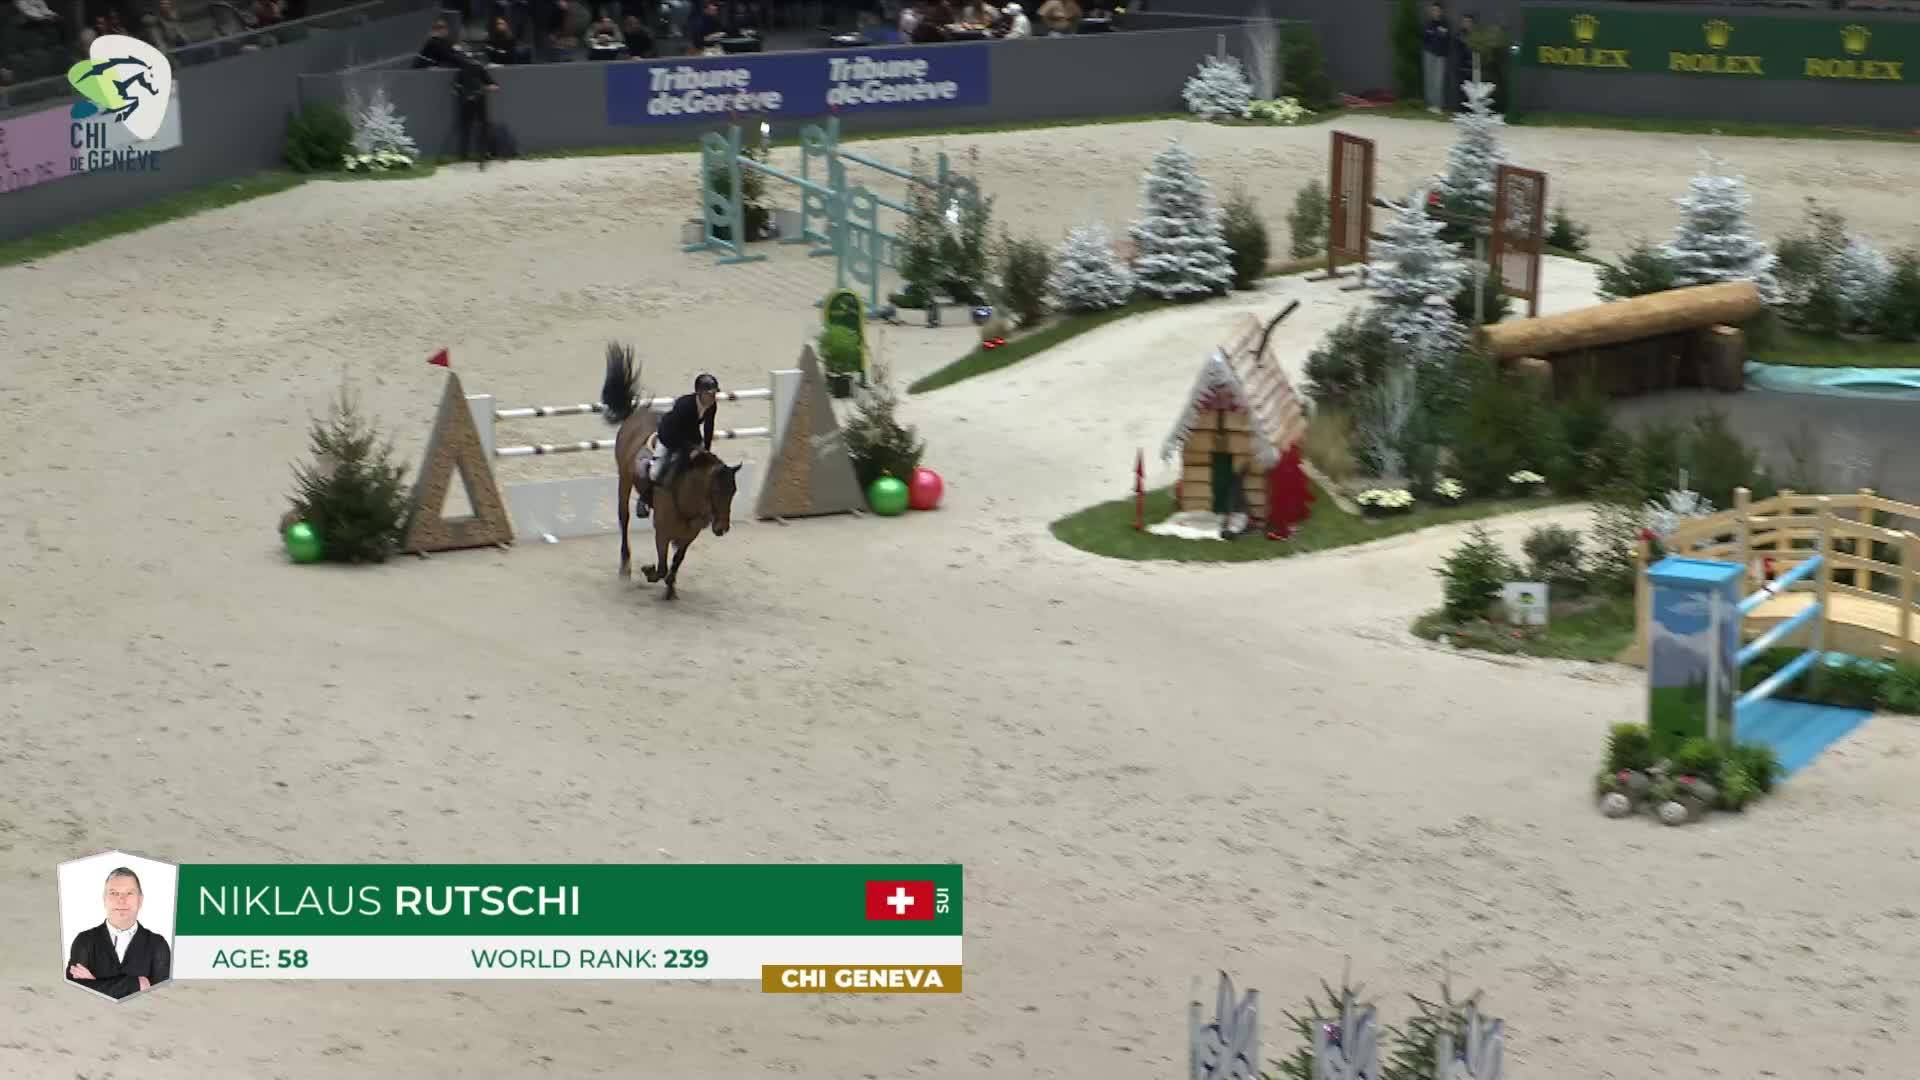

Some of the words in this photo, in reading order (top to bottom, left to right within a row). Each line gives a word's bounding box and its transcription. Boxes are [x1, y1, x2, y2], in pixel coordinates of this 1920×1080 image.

[828, 56, 929, 81] Tribune
[1537, 45, 1632, 69] ROLEX
[1668, 51, 1764, 75] ROLEX
[1804, 57, 1904, 80] ROLEX
[648, 66, 751, 92] Tribune
[827, 78, 957, 106] deGenève
